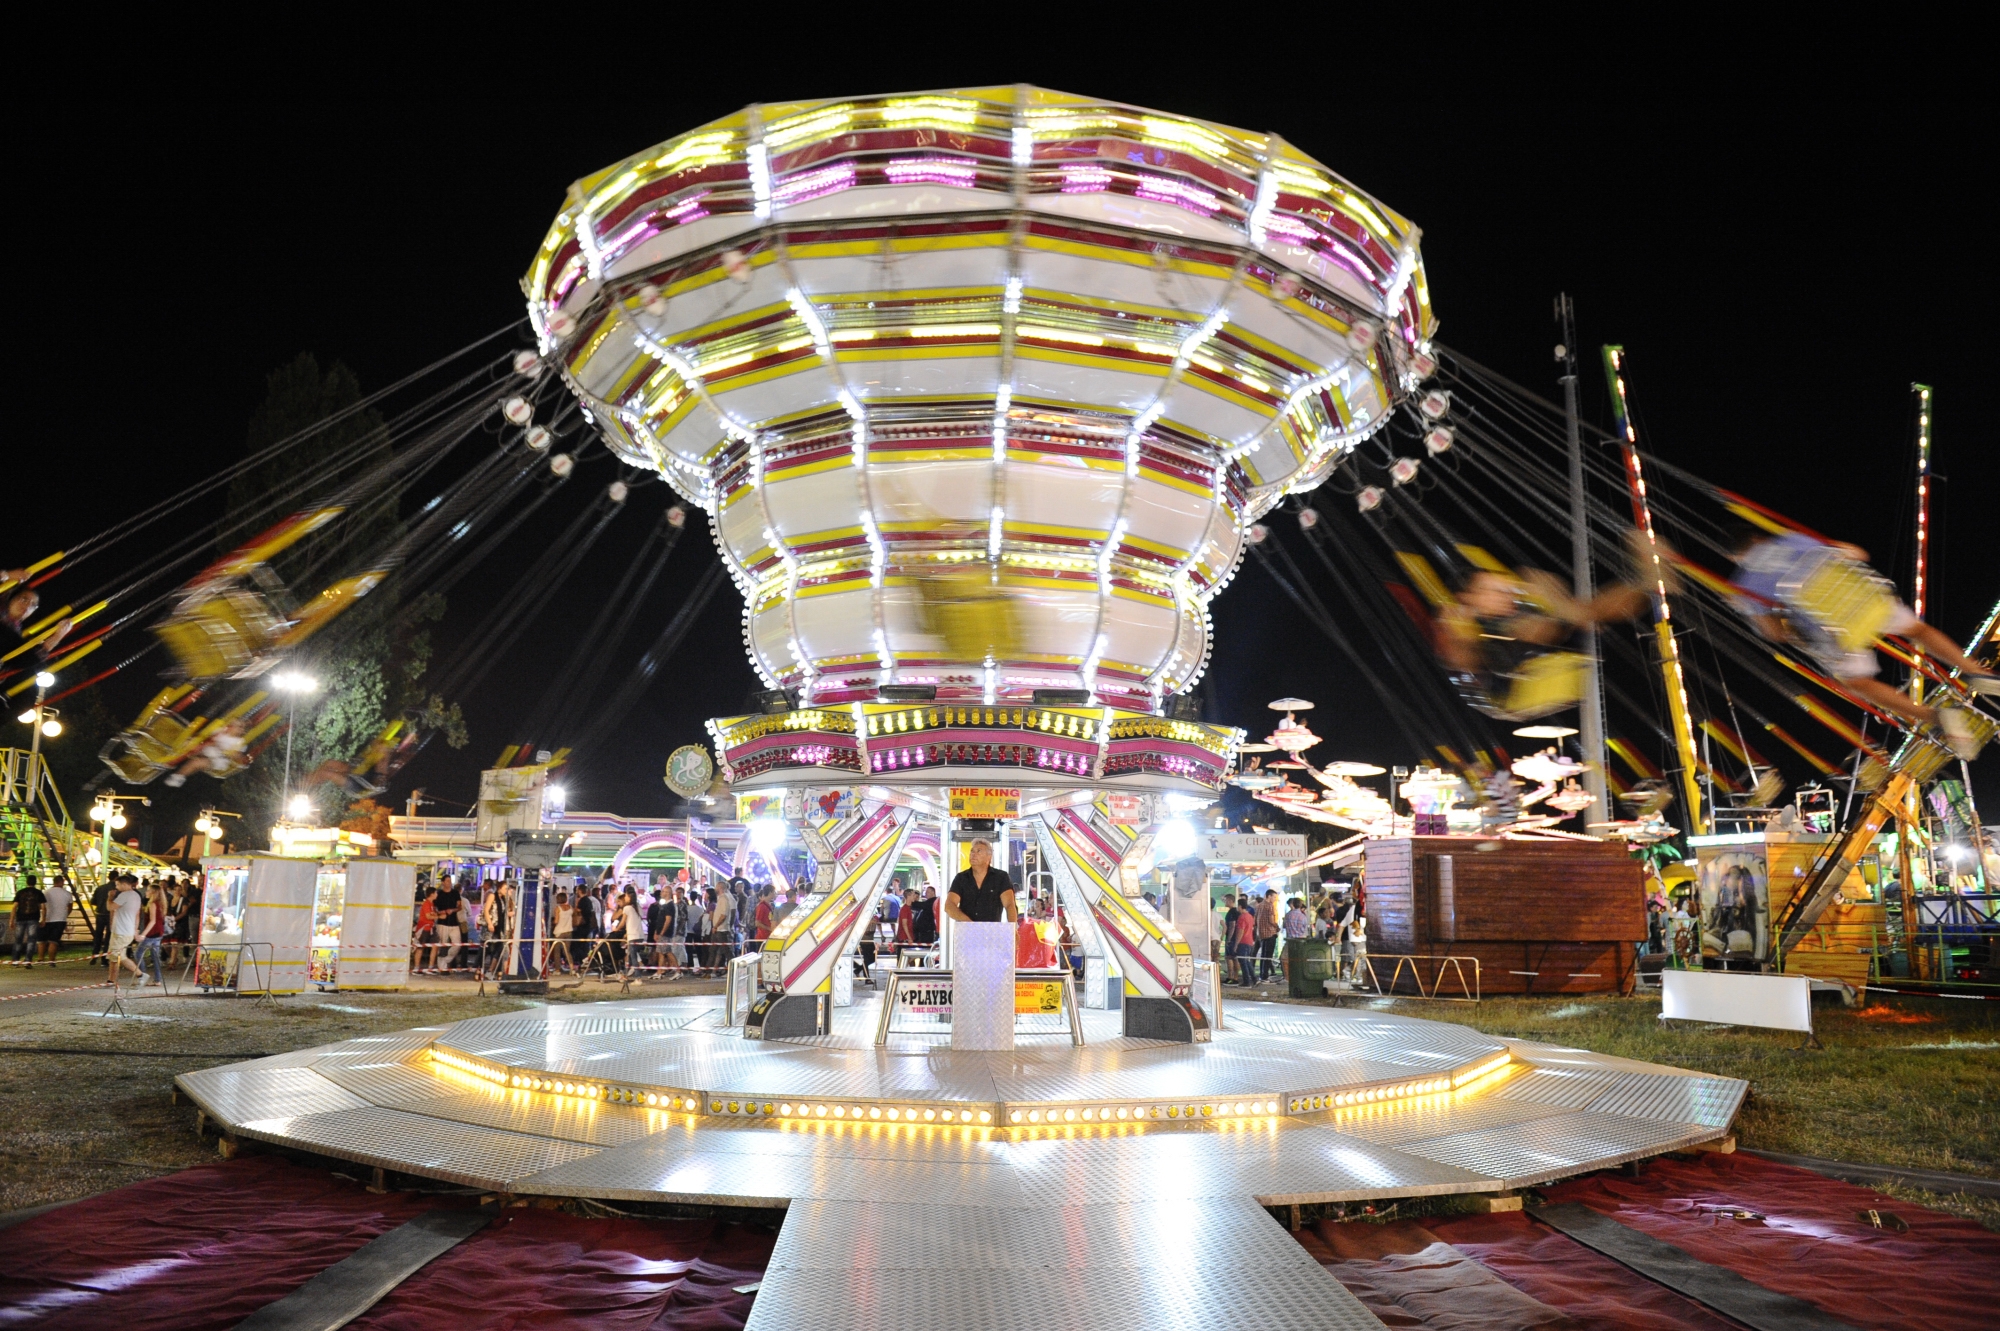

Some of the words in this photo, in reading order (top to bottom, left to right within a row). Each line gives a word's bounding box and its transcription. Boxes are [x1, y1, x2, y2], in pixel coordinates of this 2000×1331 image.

[950, 788, 978, 796] THE
[985, 788, 1020, 797] KING
[1265, 848, 1303, 858] LEAGUE
